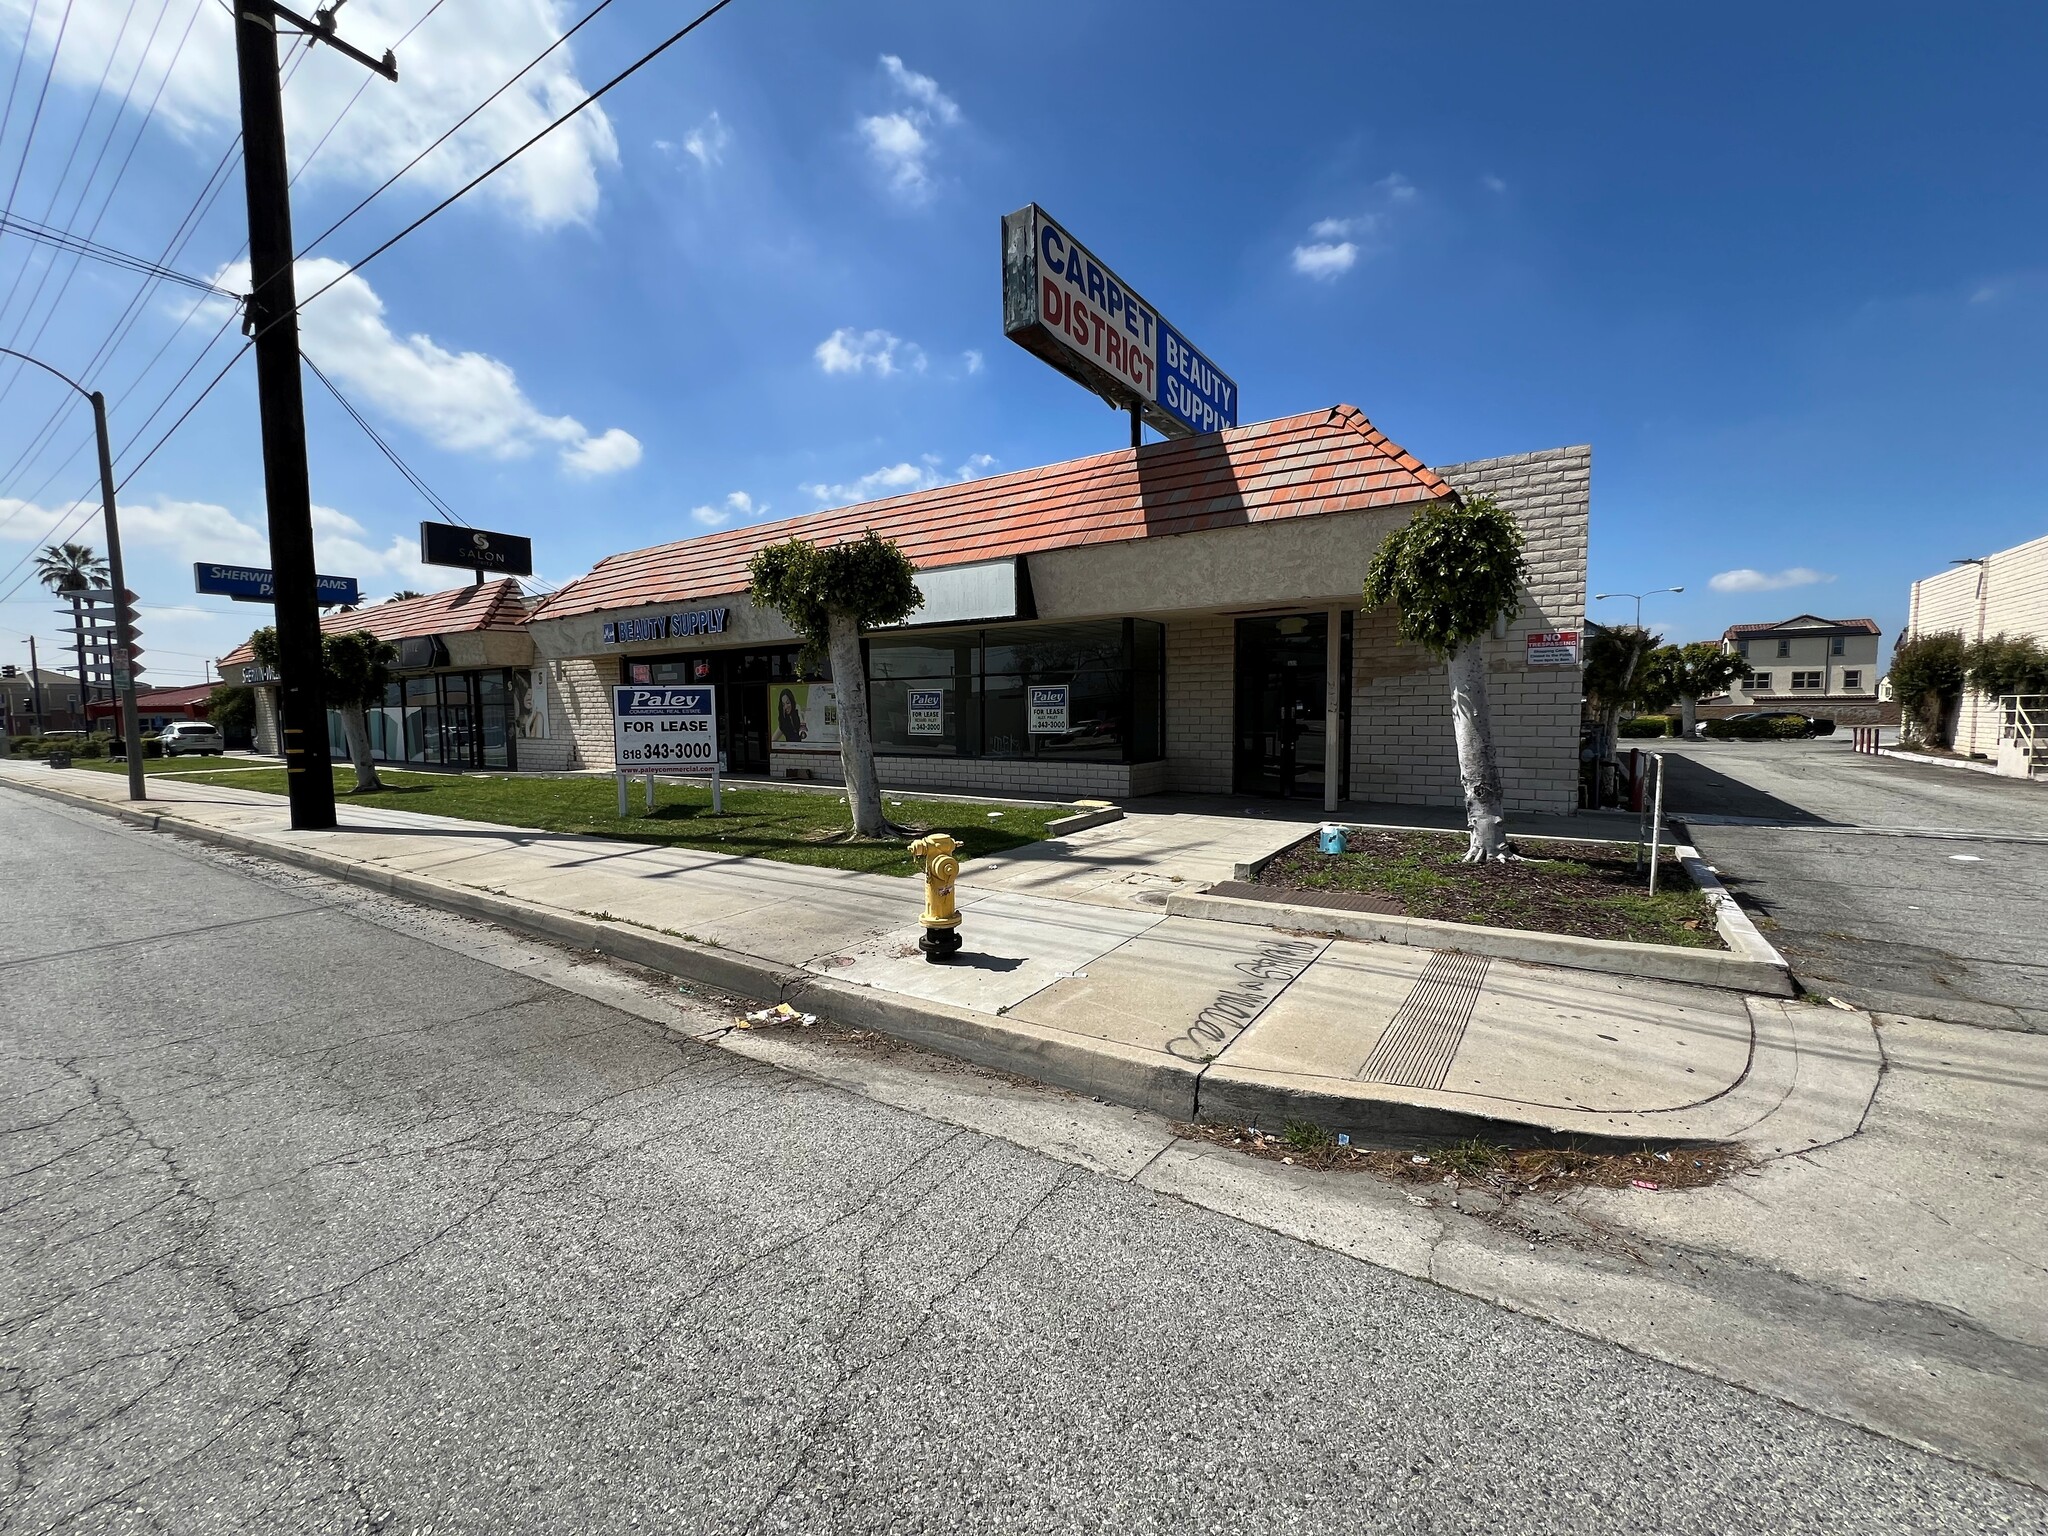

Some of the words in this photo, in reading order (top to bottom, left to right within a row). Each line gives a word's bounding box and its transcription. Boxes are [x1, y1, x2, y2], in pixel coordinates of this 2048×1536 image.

[1041, 225, 1153, 348] CARPET
[1043, 276, 1154, 394] DISTRICT
[1166, 333, 1231, 411] BEAUTY
[459, 548, 504, 562] SALON
[618, 616, 667, 643] BEAUTY
[671, 608, 726, 637] SUPPLY
[1543, 633, 1561, 641] NO
[630, 691, 700, 709] Paley
[912, 694, 939, 706] Paley
[1034, 691, 1064, 703] Paley
[623, 721, 654, 732] FOR
[661, 721, 708, 732] LEASE
[1038, 721, 1066, 729] 343-3000
[623, 749, 642, 760] 818
[644, 742, 712, 759] 343-3000
[621, 766, 715, 774] www.paleycommercial.com
